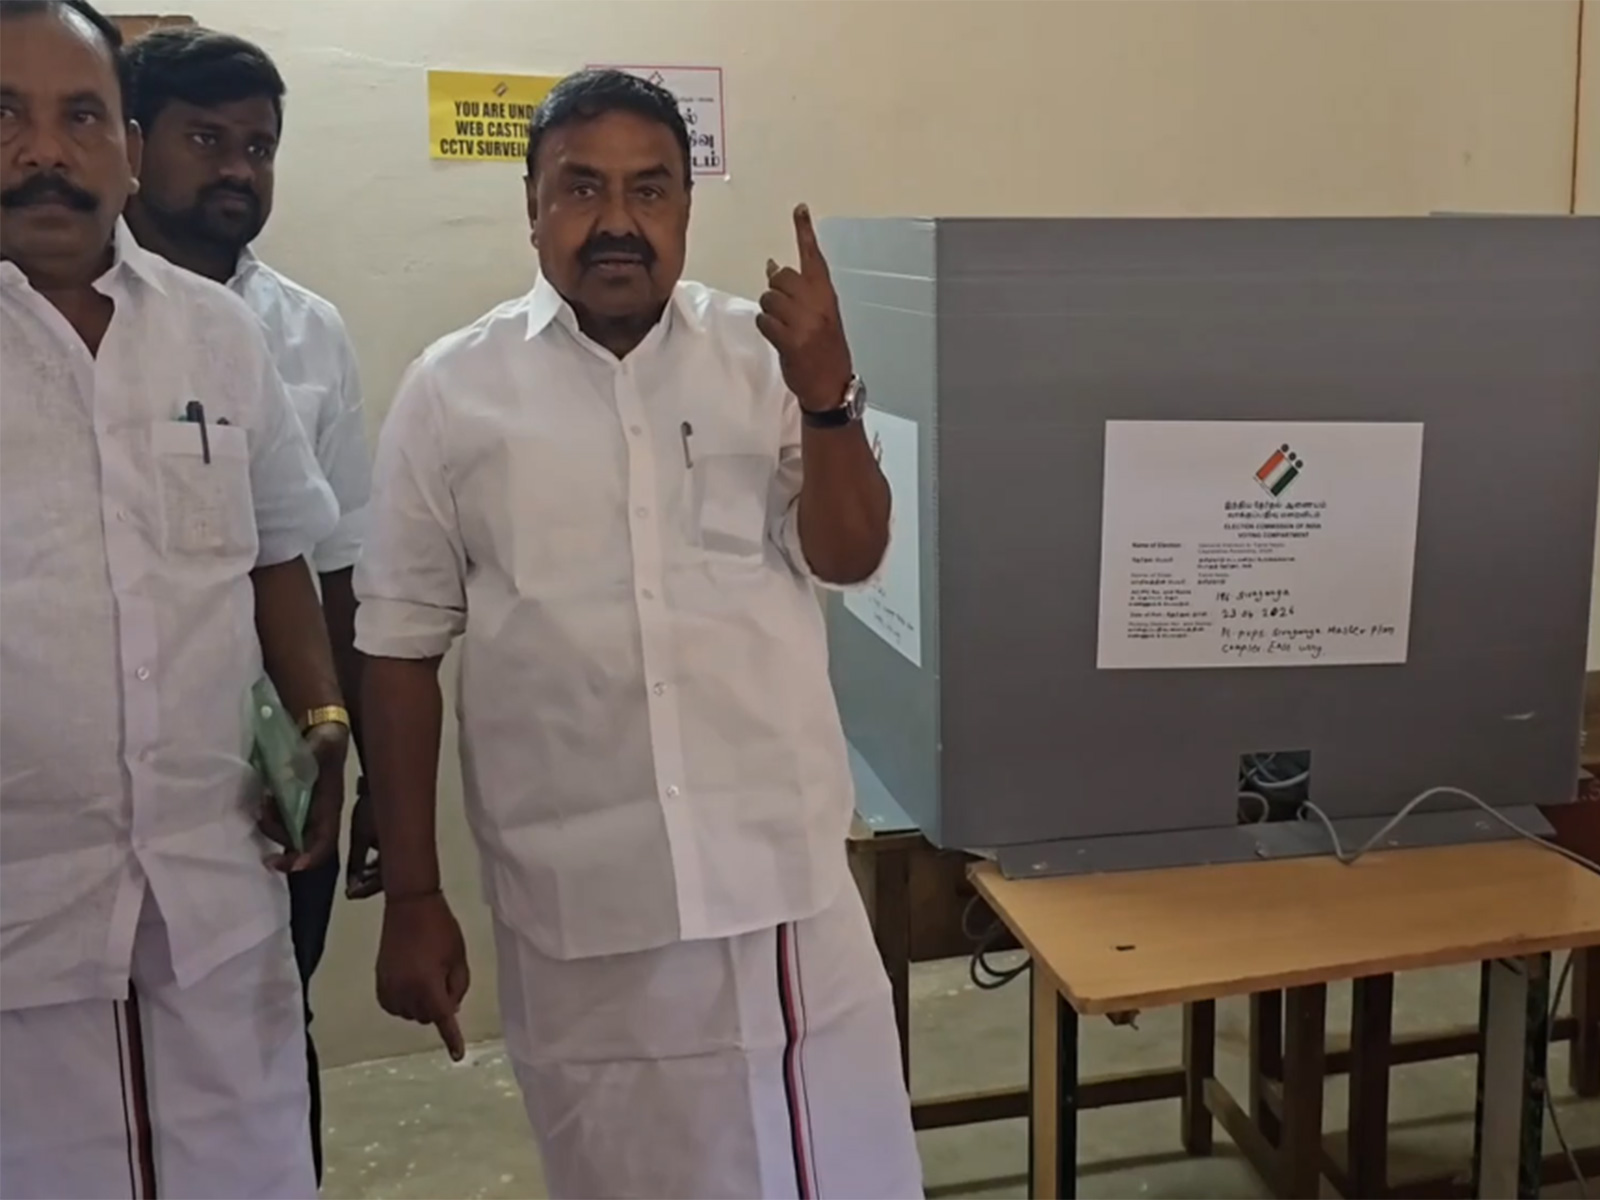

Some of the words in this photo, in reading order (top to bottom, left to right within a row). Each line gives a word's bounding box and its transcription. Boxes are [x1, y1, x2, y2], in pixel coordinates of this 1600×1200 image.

[455, 101, 480, 118] YOU
[482, 102, 505, 119] ARE
[508, 104, 537, 120] UND
[455, 120, 484, 136] WEB
[487, 122, 530, 138] CASTIN
[440, 138, 475, 155] CCTV
